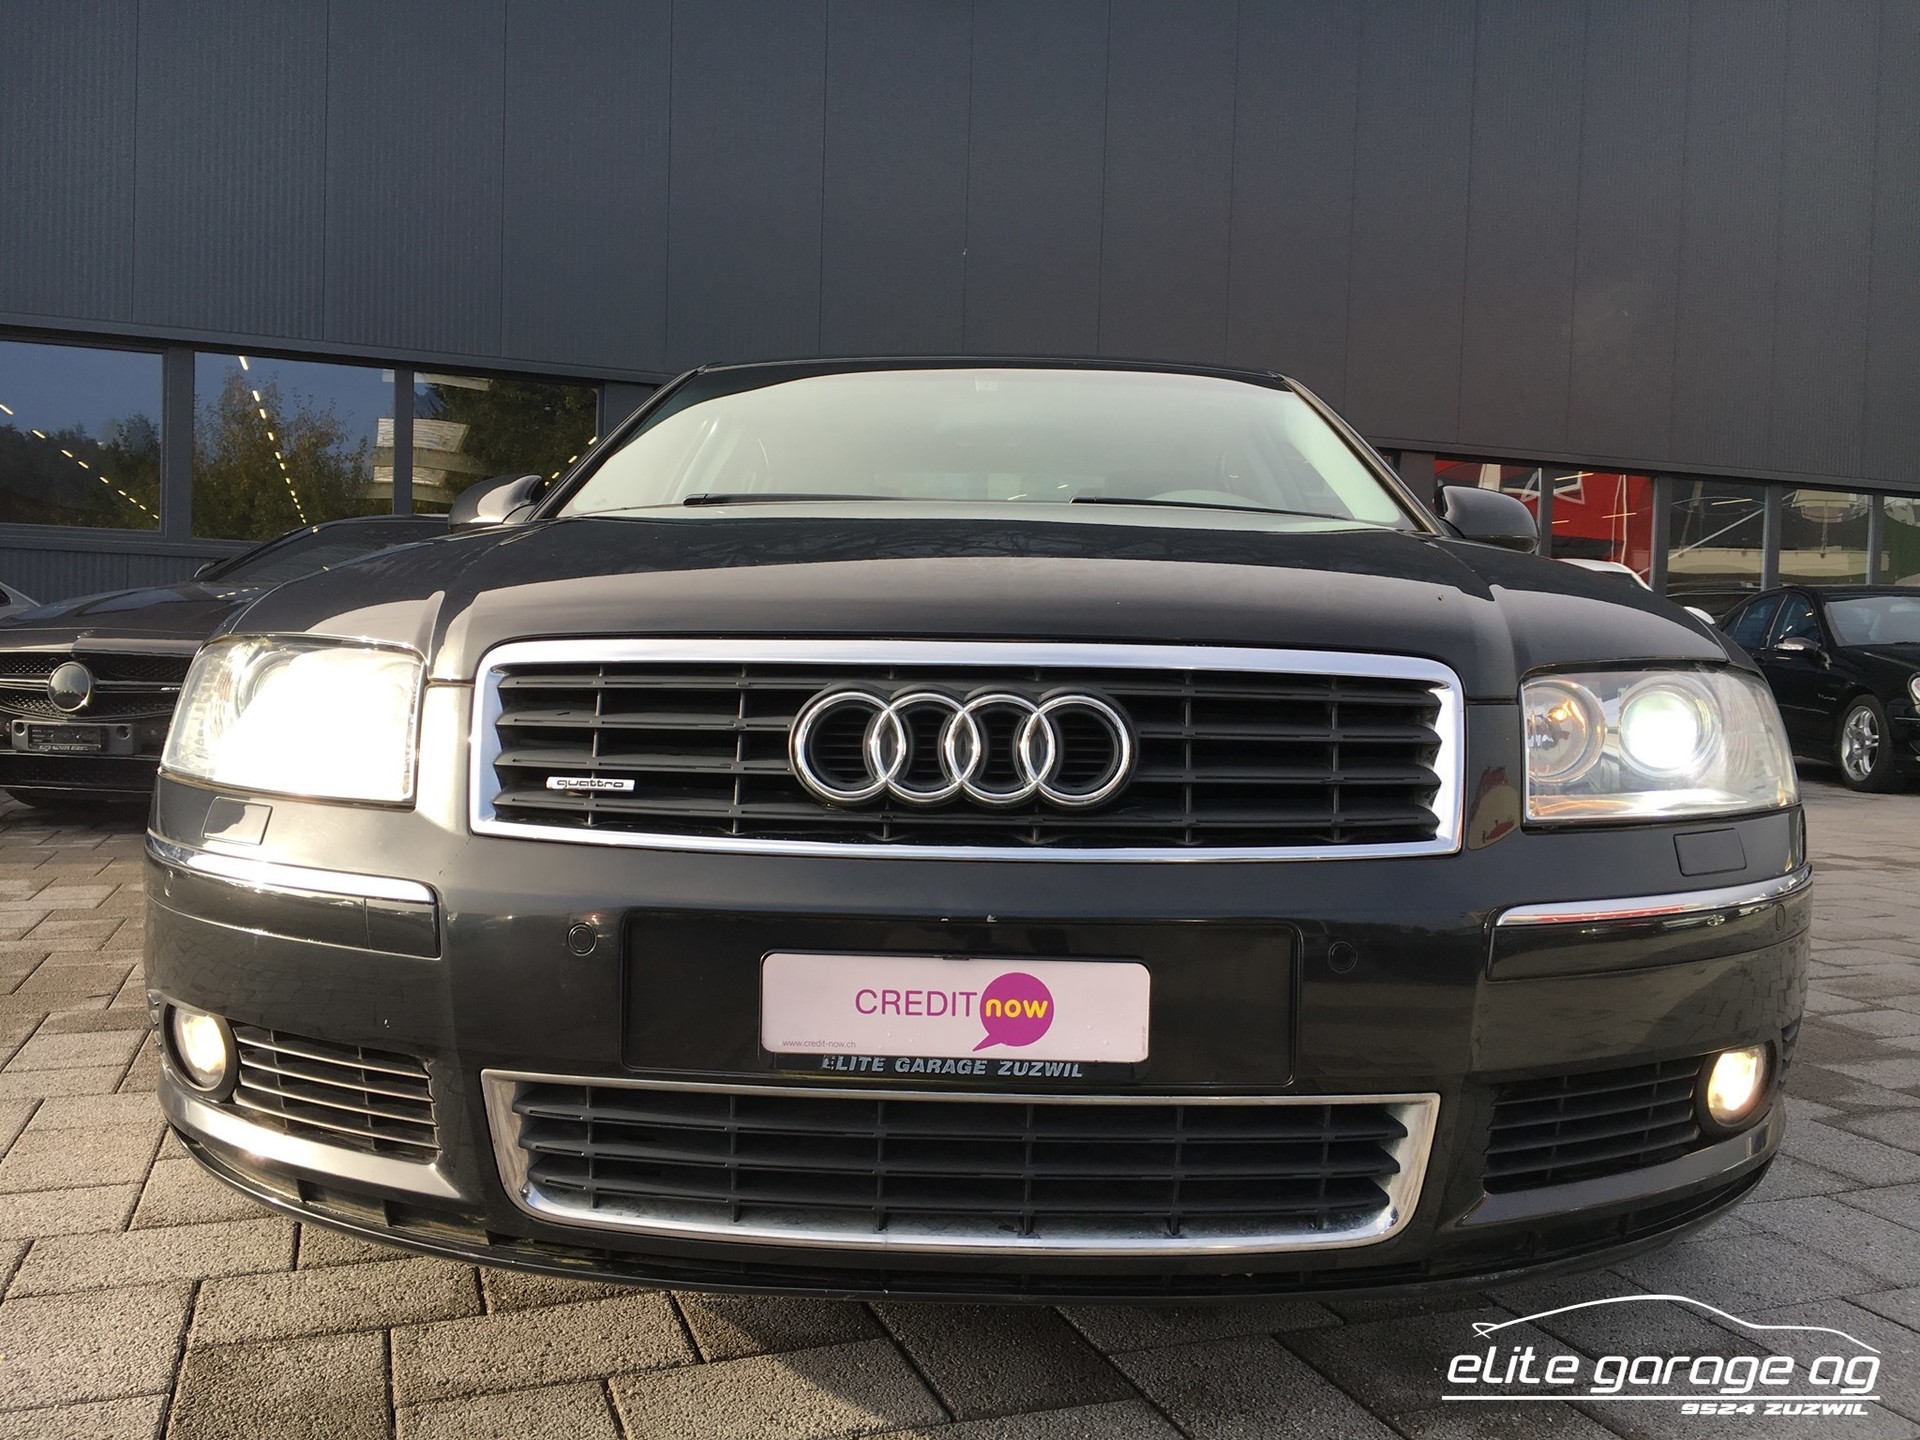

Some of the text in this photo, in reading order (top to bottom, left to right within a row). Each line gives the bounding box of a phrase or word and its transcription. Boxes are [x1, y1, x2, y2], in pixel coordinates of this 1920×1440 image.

[556, 779, 624, 788] quattro
[855, 988, 1049, 1019] CREDIT now
[782, 1039, 856, 1049] www.credit-now.ch
[821, 1055, 1083, 1078] ELITE GARAGE ZUZWIL
